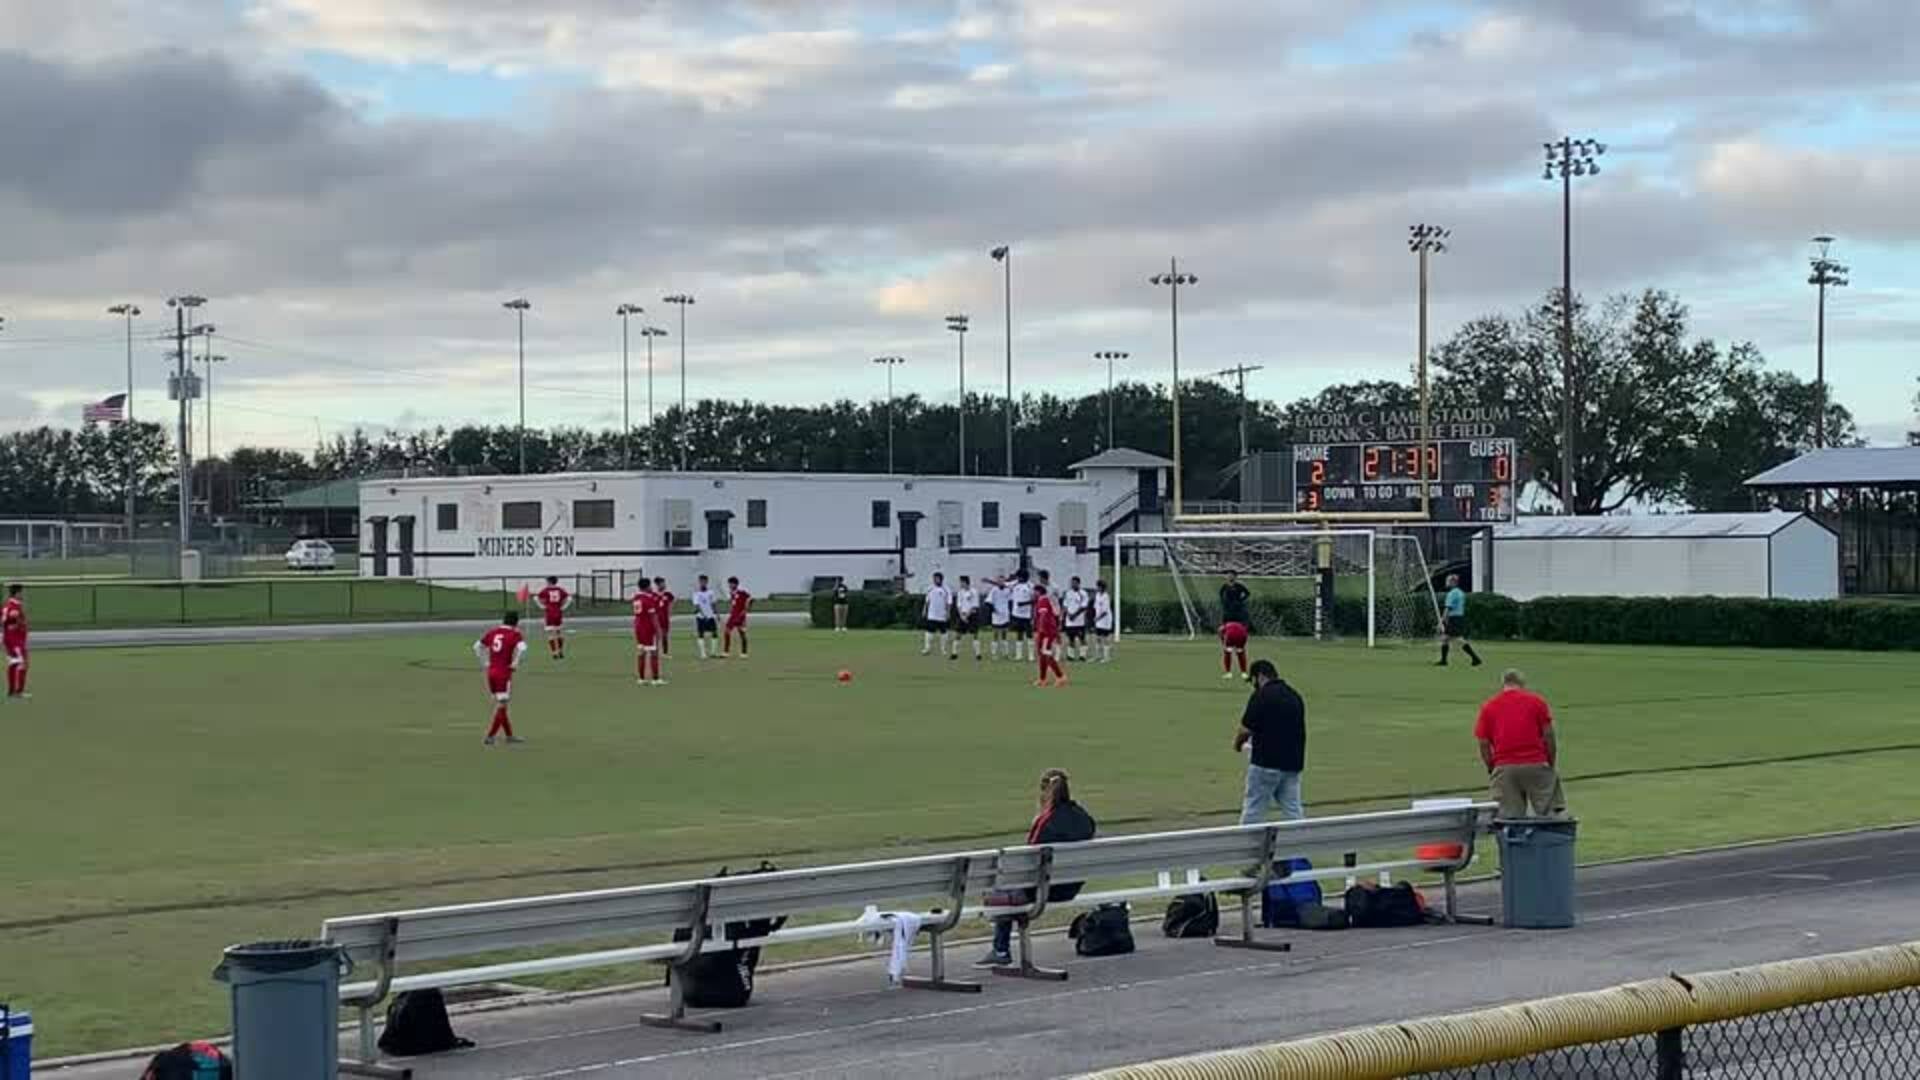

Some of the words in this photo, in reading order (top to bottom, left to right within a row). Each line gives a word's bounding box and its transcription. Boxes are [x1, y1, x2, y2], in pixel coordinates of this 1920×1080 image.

[1295, 412, 1351, 427] EMORY
[1431, 406, 1511, 422] STADIUM
[1309, 428, 1361, 442] FRANK
[1366, 427, 1380, 441] S.
[1451, 423, 1496, 437] FIELD
[1295, 446, 1329, 461] HOME
[1469, 441, 1510, 457] GUEST
[1312, 461, 1323, 484] 2
[1495, 457, 1508, 479] 0
[1309, 491, 1318, 508] 3
[1324, 487, 1355, 499] DOWN
[1363, 486, 1376, 499] TO
[1378, 485, 1392, 499] GO
[1453, 484, 1475, 497] QTR
[478, 535, 535, 557] MINERS
[543, 535, 575, 557] DEN
[492, 633, 504, 652] 5
